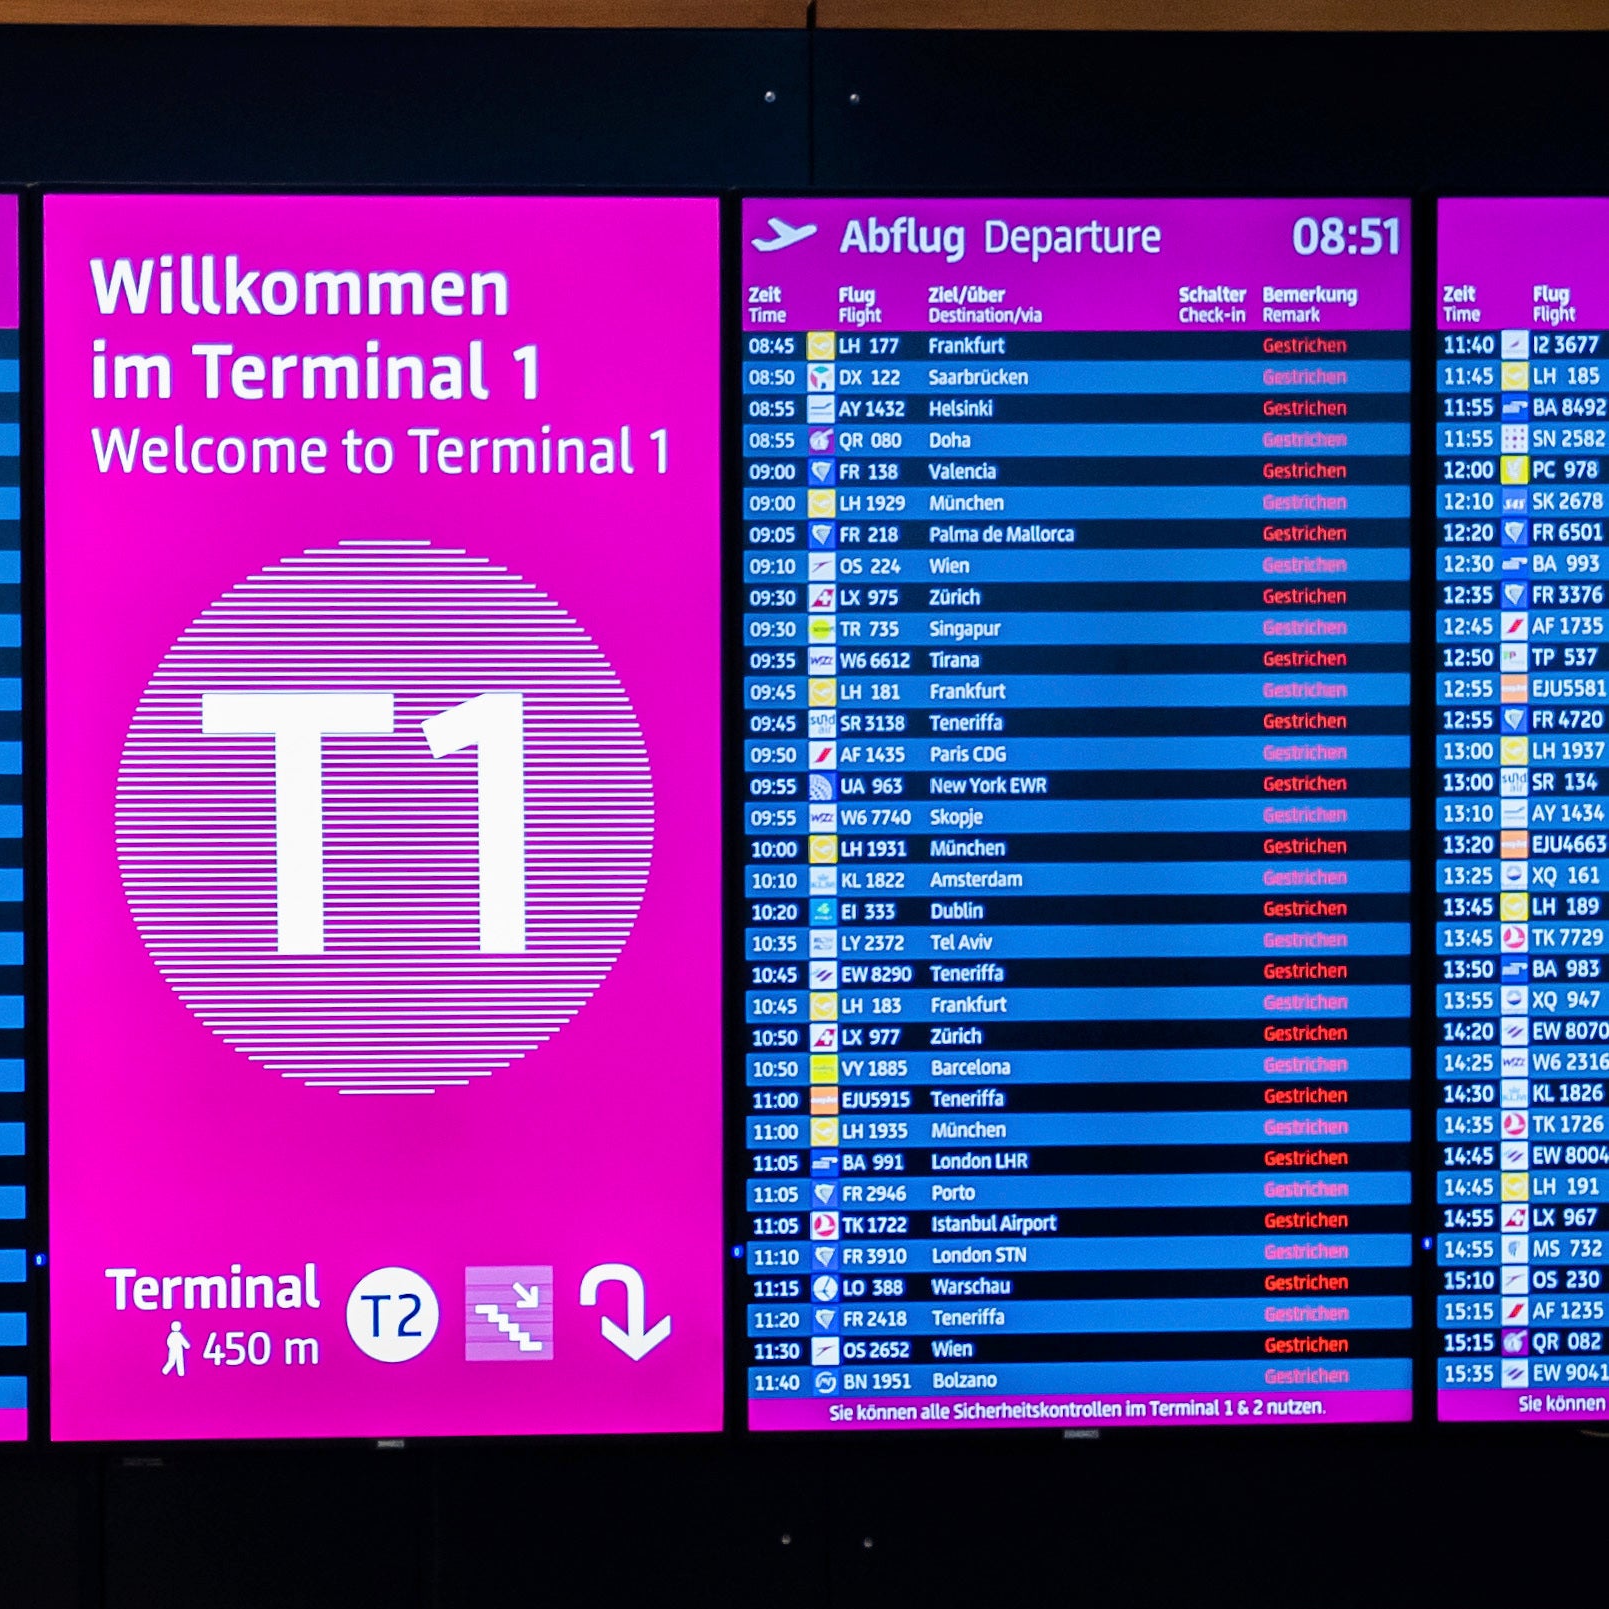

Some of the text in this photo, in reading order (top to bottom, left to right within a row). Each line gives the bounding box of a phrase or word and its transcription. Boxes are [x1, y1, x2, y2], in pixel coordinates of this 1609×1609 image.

[839, 216, 1399, 263] Abflug Departure 08:51
[89, 254, 508, 316] Willkommen
[748, 285, 1358, 309] Zeit Flug Ziel/über Schalter Bemerkung
[1443, 284, 1571, 307] Zeit Flug
[748, 304, 1321, 328] Time Flight Destination/via Check-in Remark
[1443, 303, 1576, 327] Time Flight
[748, 335, 1347, 354] 08:45 LH 177 Frankfurt Gestrichen
[1444, 335, 1495, 354] 11:40
[93, 338, 538, 401] im Terminal 1
[90, 424, 667, 475] Welcome to Terminal 1
[1444, 461, 1494, 479] 12:00
[202, 693, 526, 956] T1
[104, 1262, 321, 1311] Terminal
[361, 1293, 423, 1340] T2
[202, 1331, 319, 1366] 450 m
[755, 1336, 1349, 1360] 11:30 OS 2652 Wien Gestrichen
[829, 1398, 1326, 1422] Sie können alle Sicherheitskontrollen im Terminal 1 & 2 nutzen.
